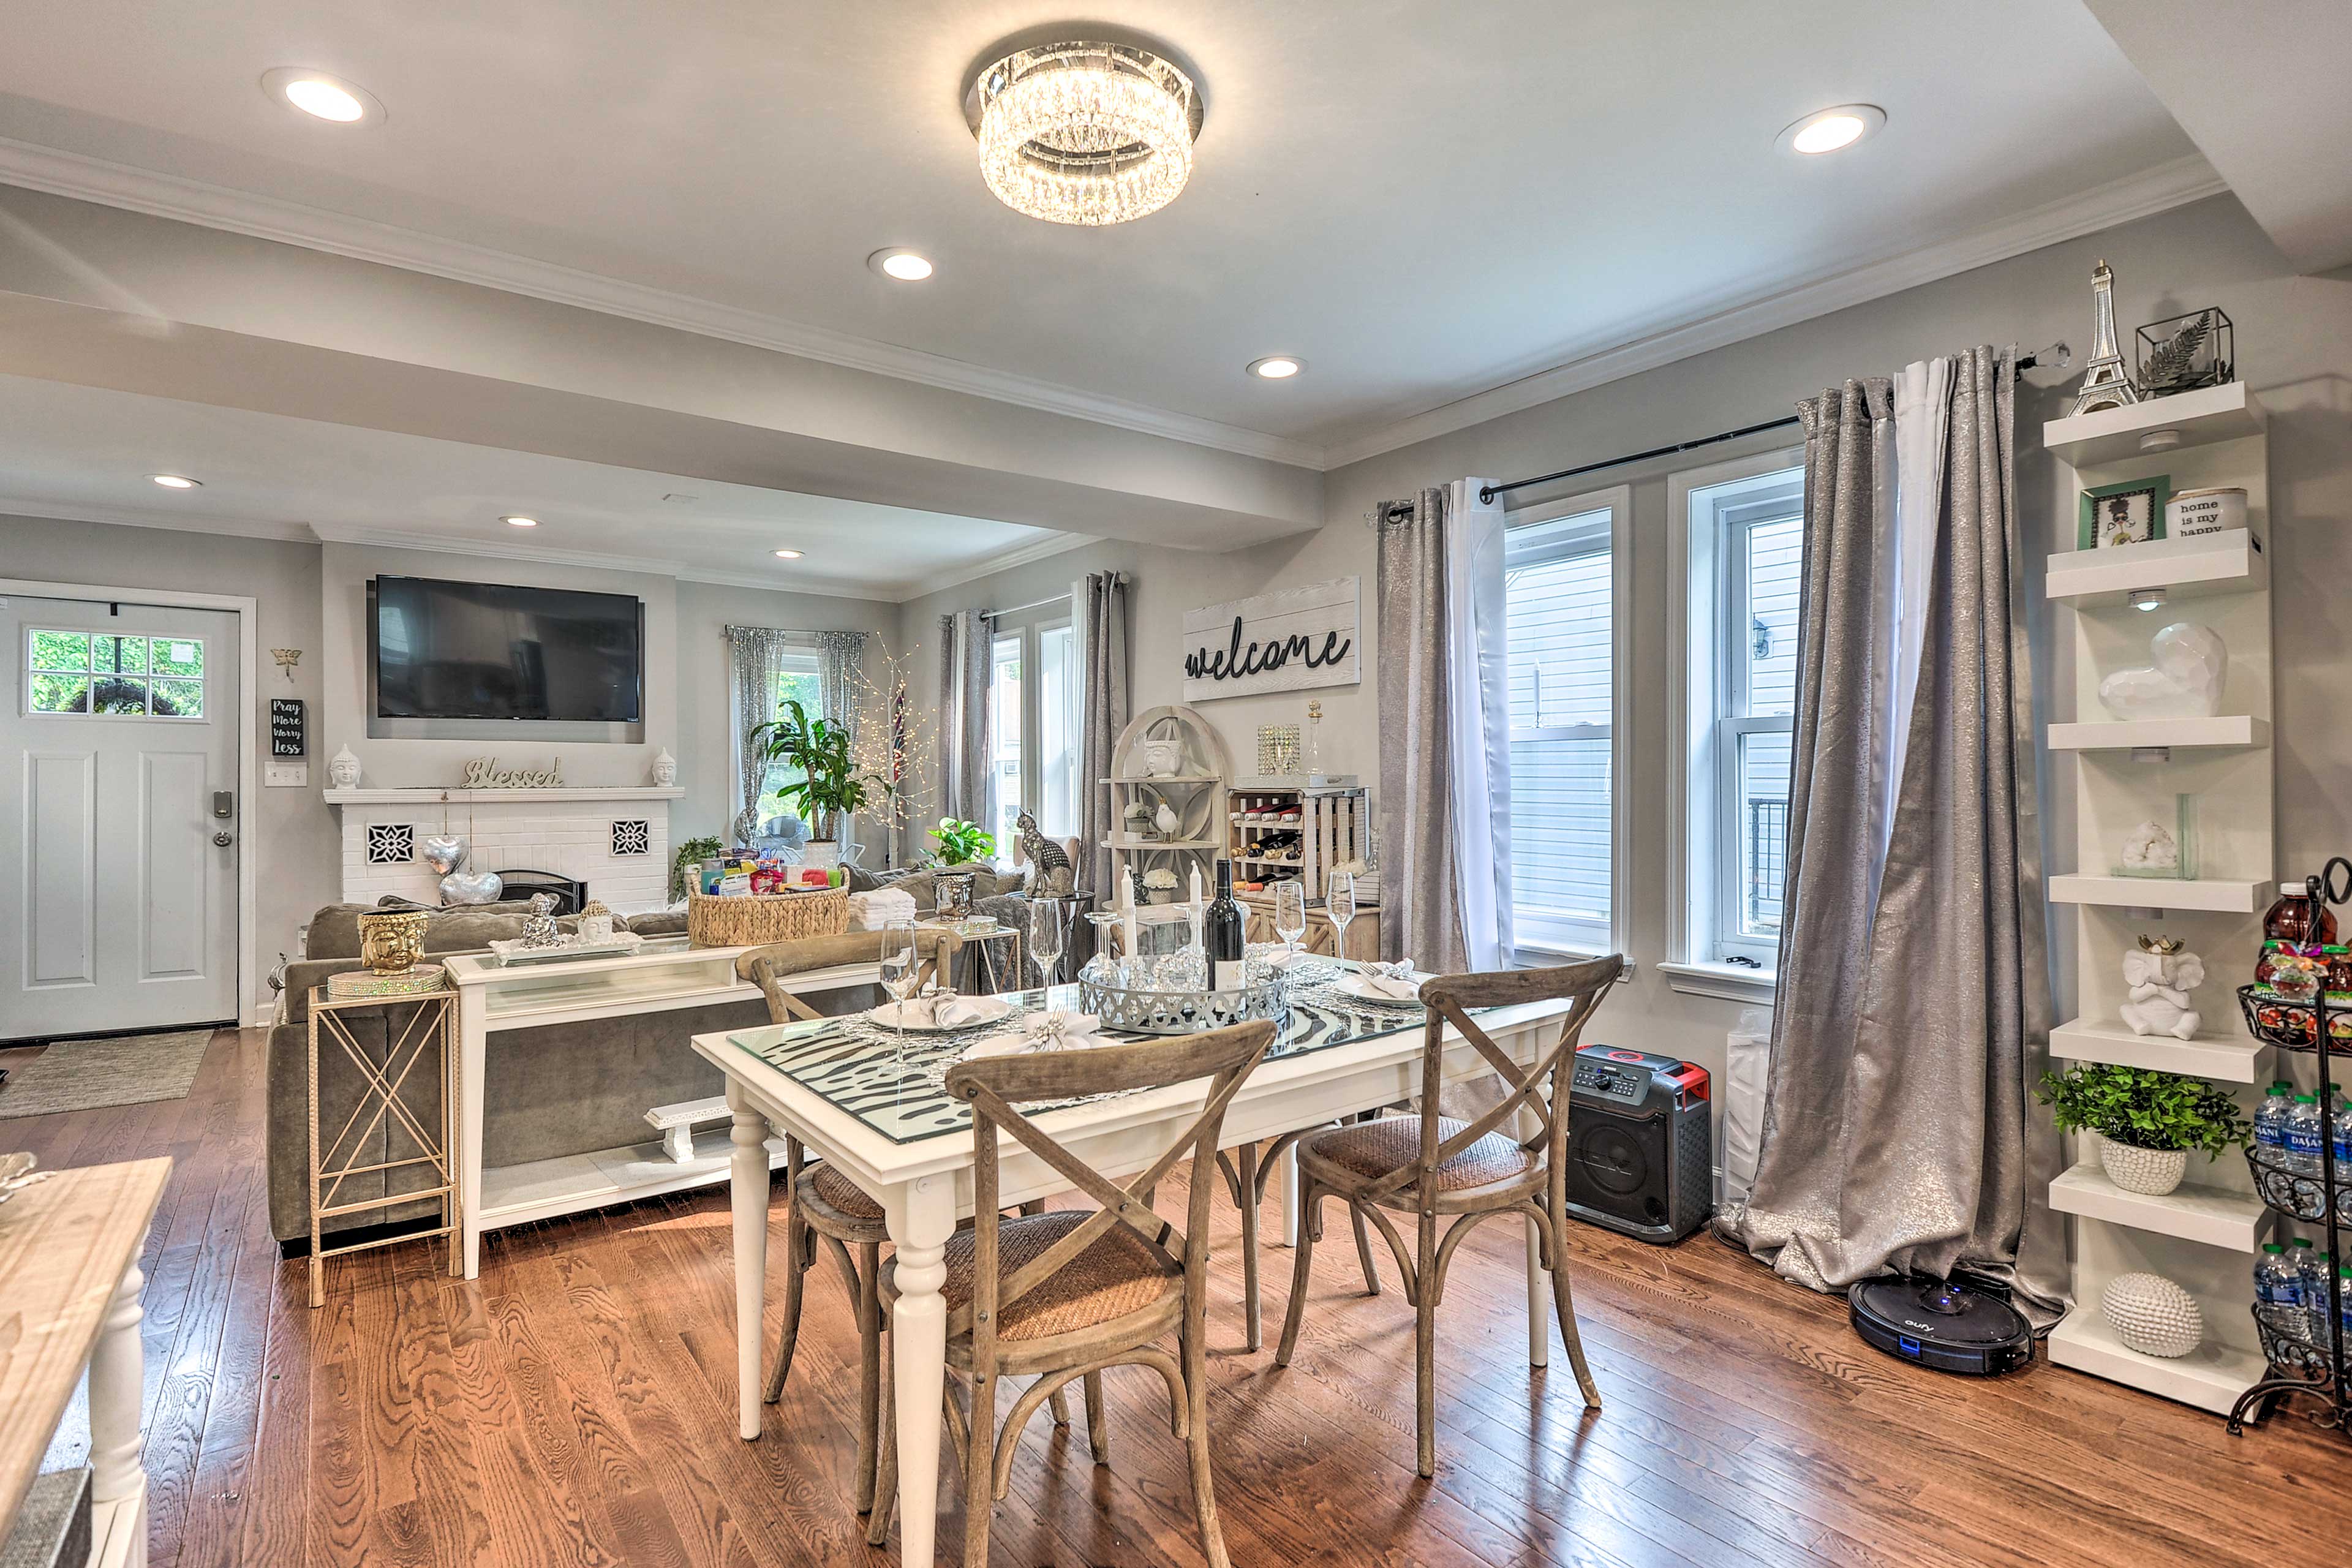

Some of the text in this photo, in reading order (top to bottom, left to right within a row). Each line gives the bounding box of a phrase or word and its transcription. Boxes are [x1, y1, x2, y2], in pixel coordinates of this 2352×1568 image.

[2180, 501, 2218, 513] home
[2197, 514, 2218, 522] my
[1185, 616, 1351, 680] welcome
[273, 700, 301, 715] Pray
[273, 715, 301, 726] More
[273, 728, 302, 740] Worry
[274, 739, 302, 754] Less
[461, 756, 564, 788] Blessed
[2255, 1125, 2279, 1137] ASANI
[2291, 1136, 2323, 1147] DASAN
